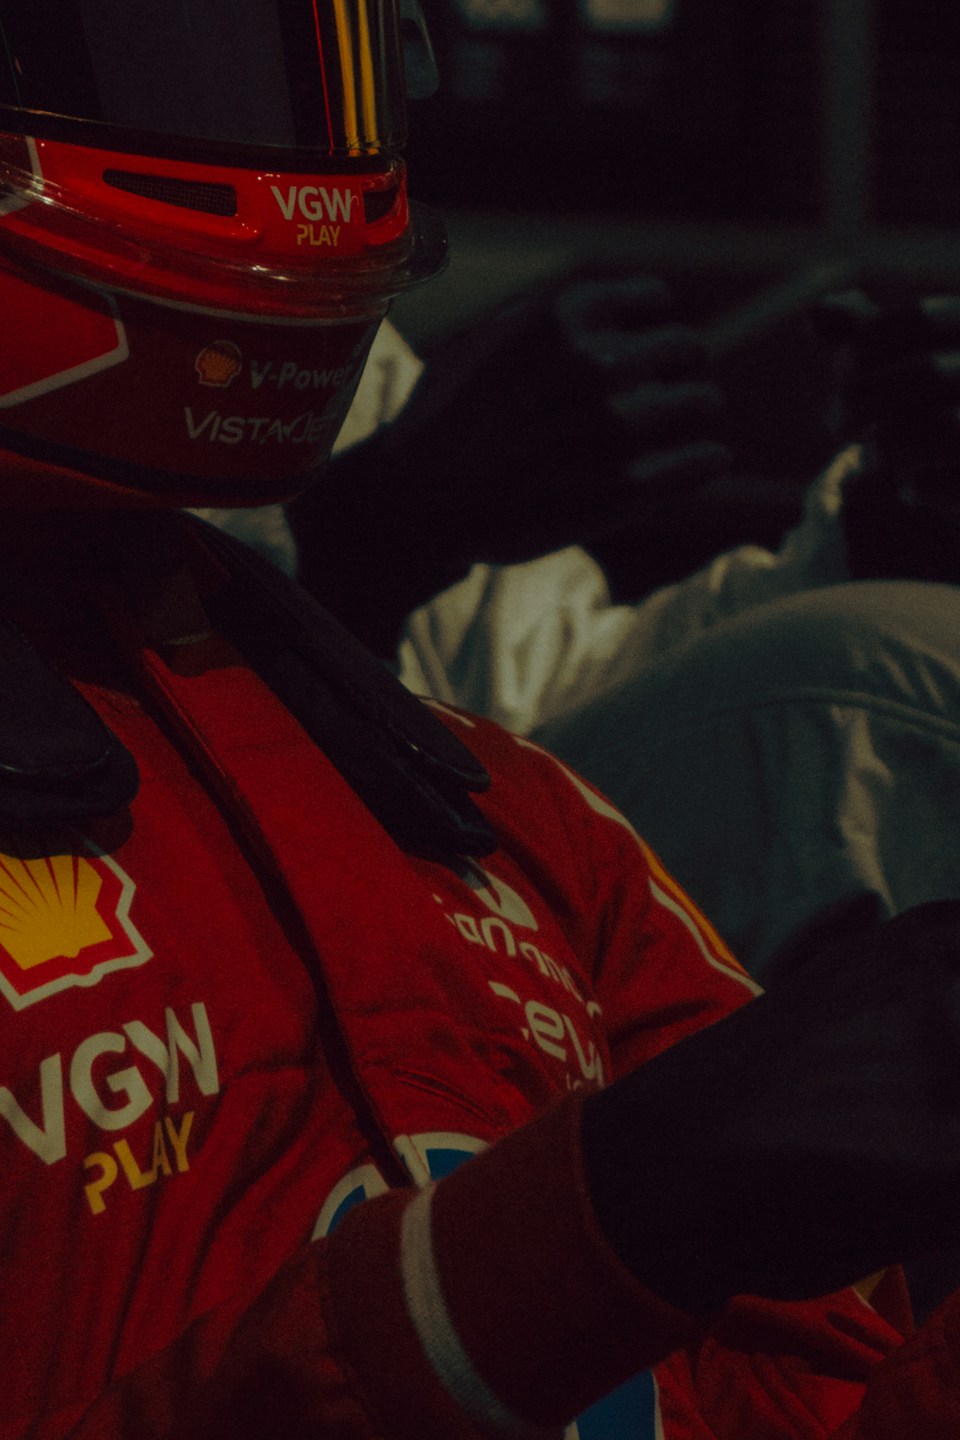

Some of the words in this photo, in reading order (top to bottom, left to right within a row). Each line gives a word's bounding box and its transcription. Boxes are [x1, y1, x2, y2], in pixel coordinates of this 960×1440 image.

[270, 185, 351, 223] VGW
[296, 224, 342, 247] PLAY
[82, 1110, 196, 1217] PLAY
